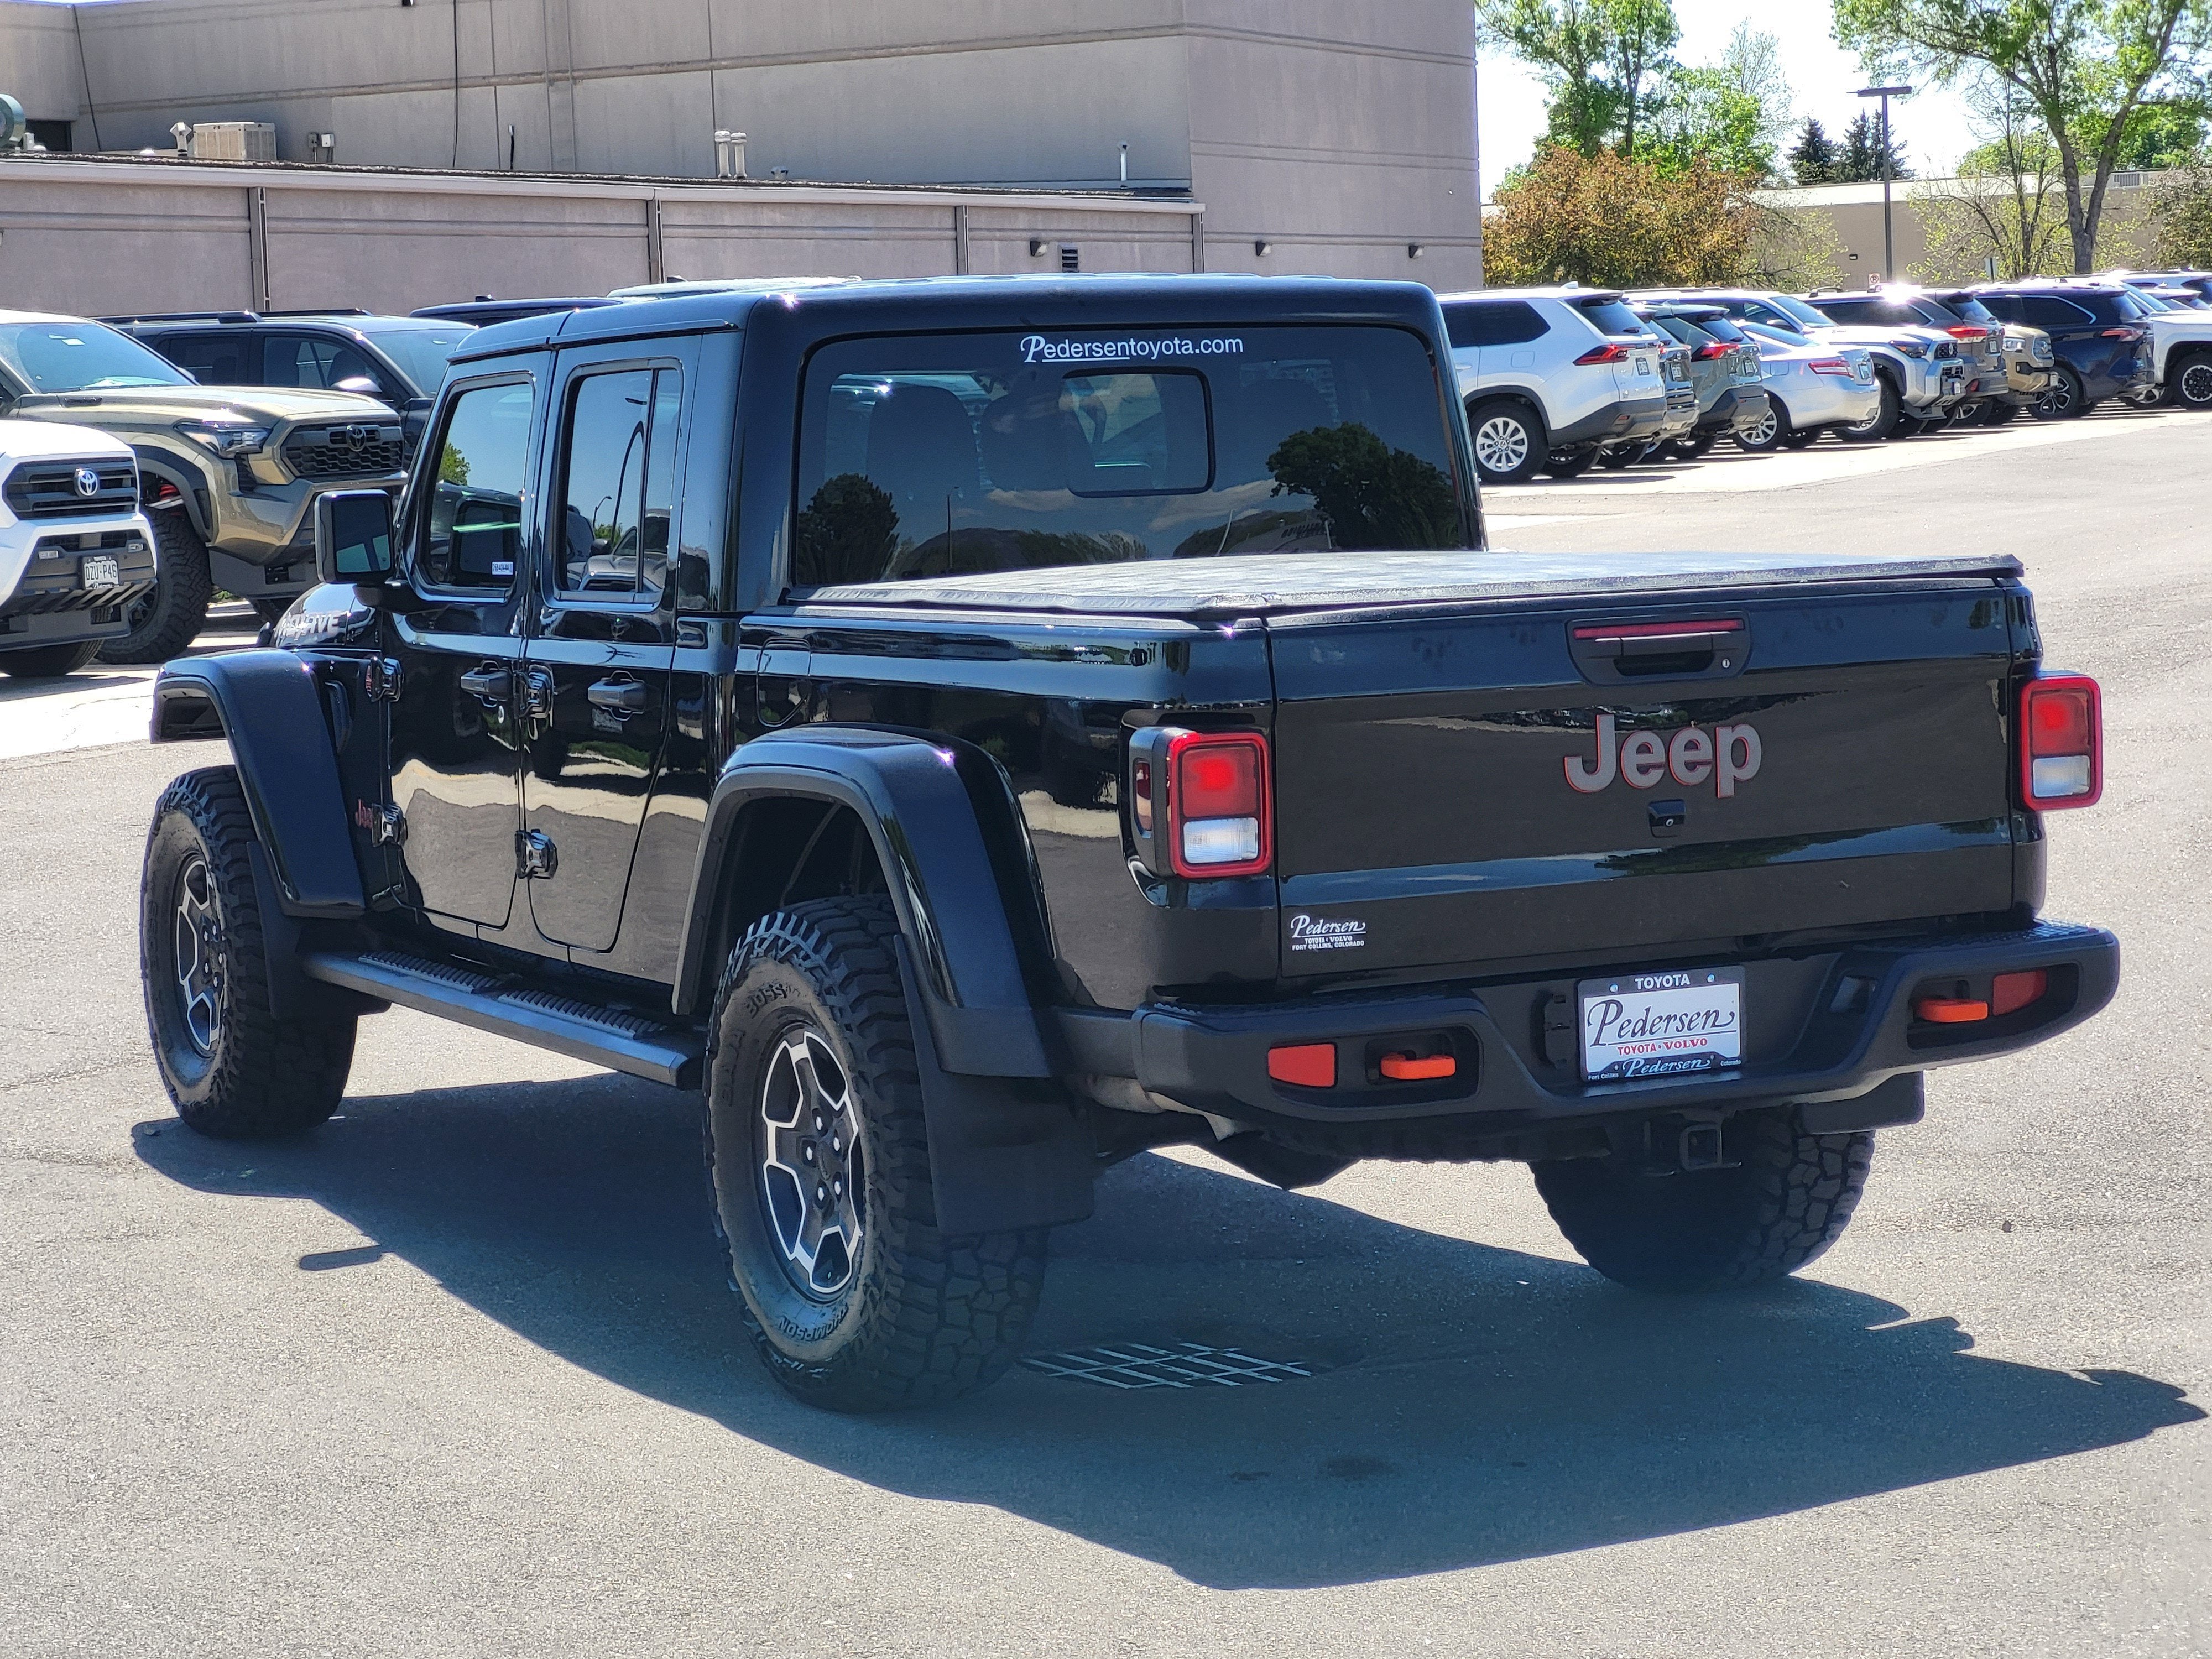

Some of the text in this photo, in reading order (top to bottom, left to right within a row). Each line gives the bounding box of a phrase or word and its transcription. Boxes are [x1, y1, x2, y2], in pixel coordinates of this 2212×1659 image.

[1020, 335, 1244, 363] Pedersentoyota.com
[1564, 713, 1762, 799] Jeep
[1290, 915, 1366, 938] Pedersen
[1635, 973, 1691, 990] TOYOTA
[1587, 999, 1735, 1047] Pedersen
[1617, 1037, 1708, 1056] TOYOTA VOLVO
[1622, 1057, 1712, 1078] Pedersen
